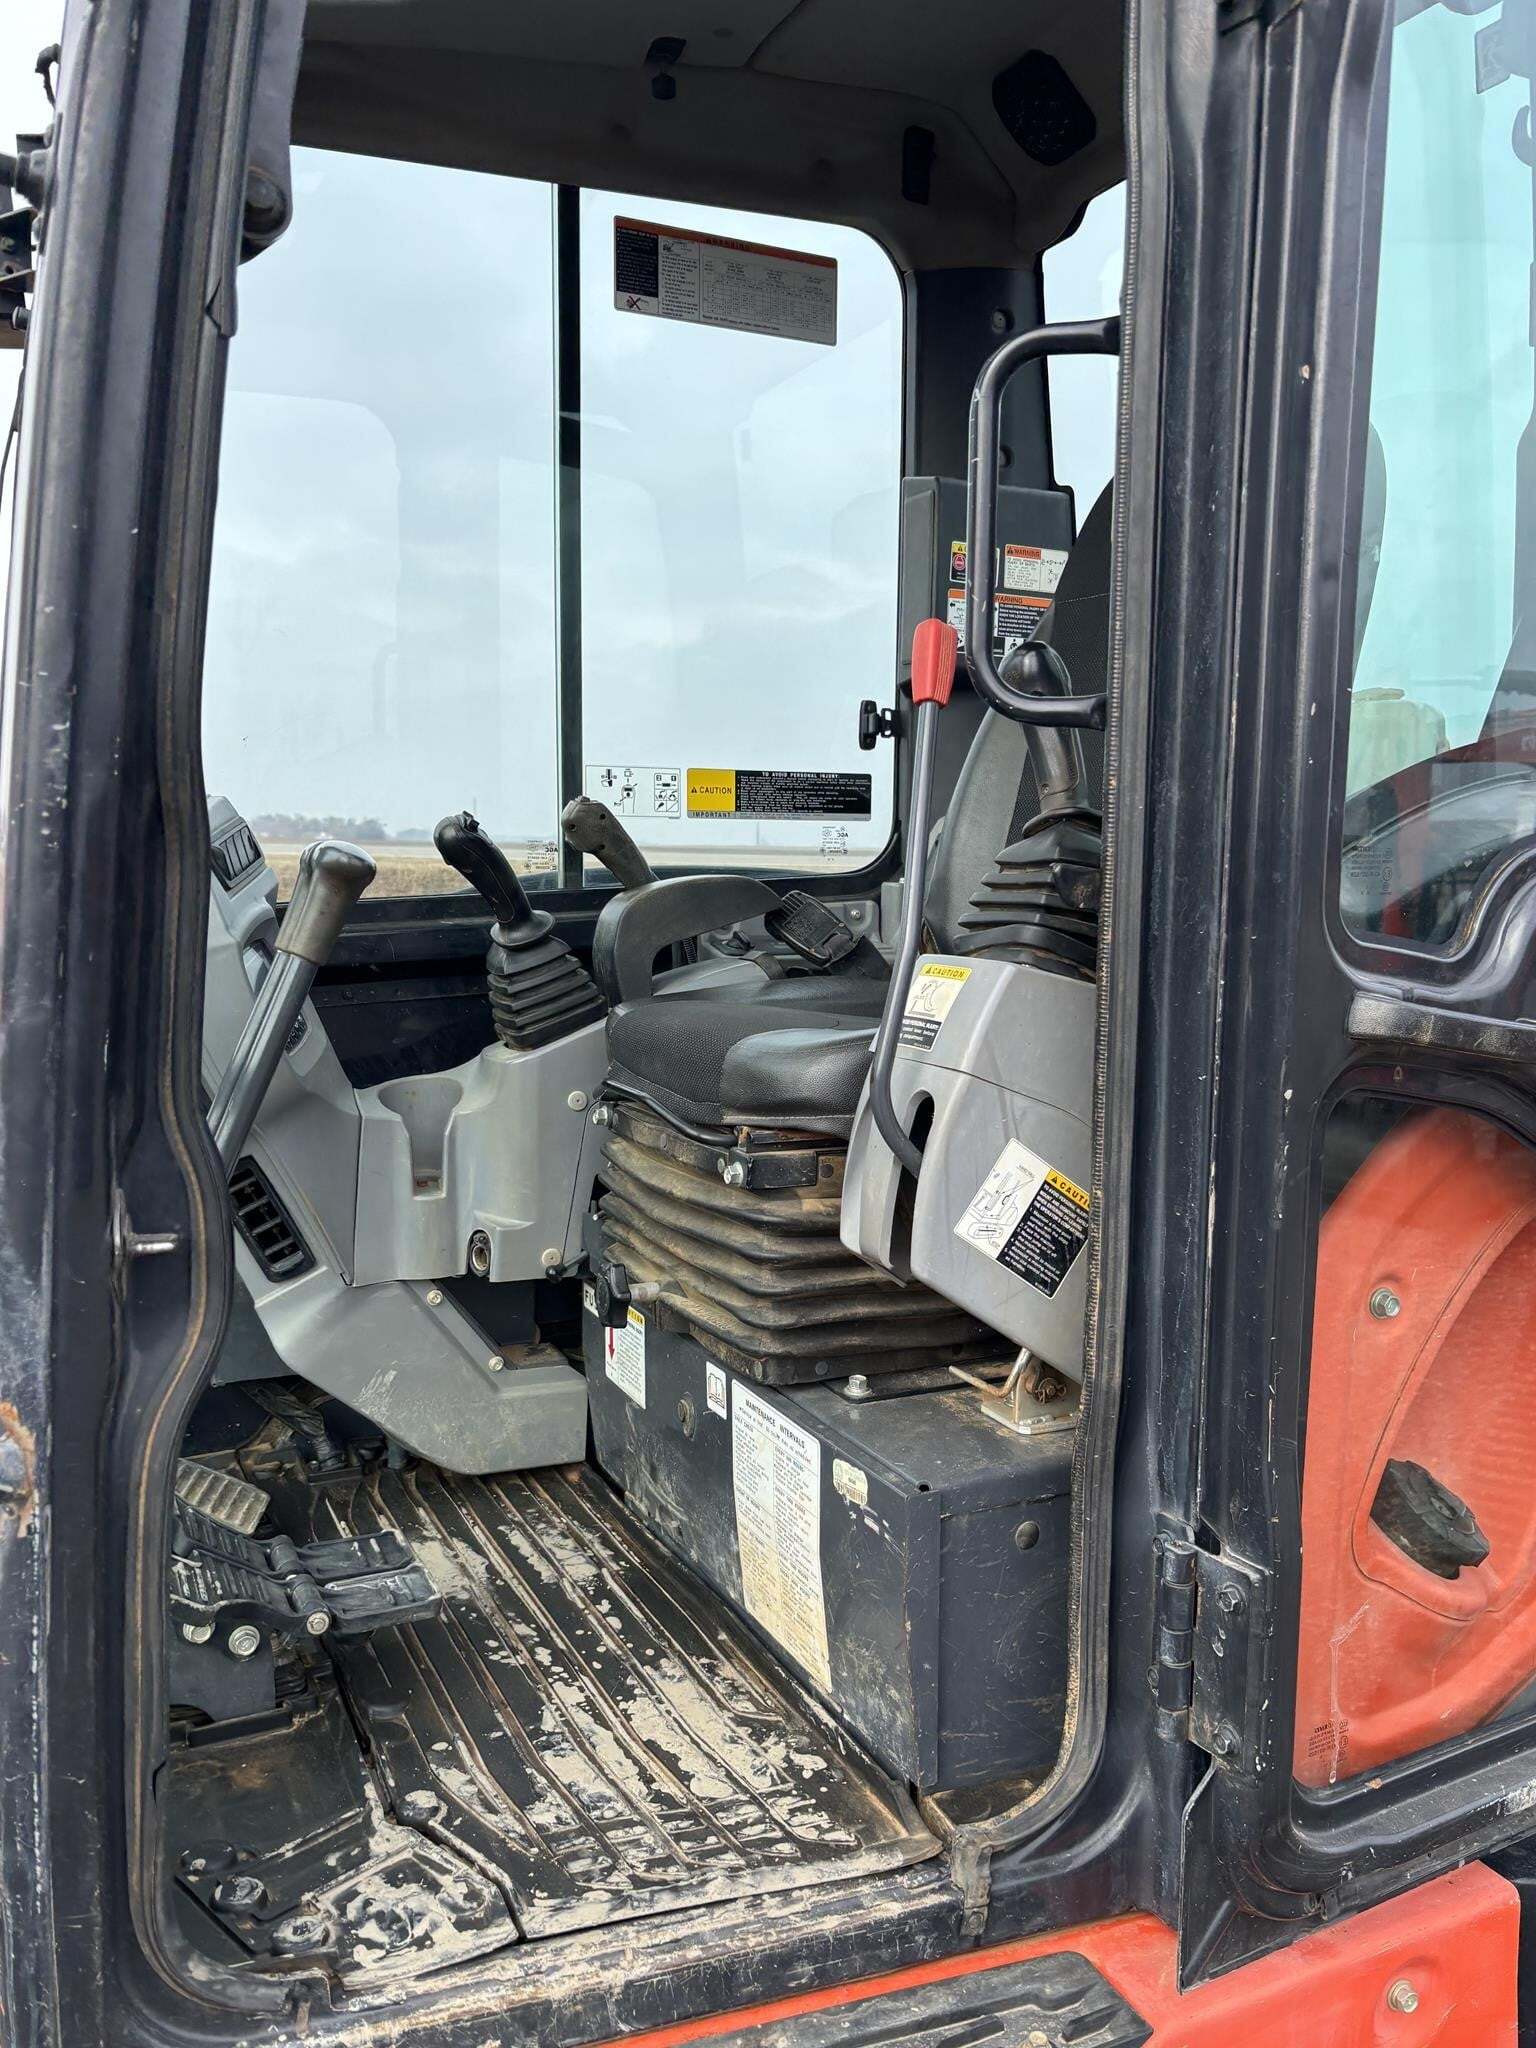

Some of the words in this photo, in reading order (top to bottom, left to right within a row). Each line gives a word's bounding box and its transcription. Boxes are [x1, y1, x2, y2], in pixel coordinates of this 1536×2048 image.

[699, 786, 732, 795] CAUTION
[692, 811, 731, 819] IMPORTANT
[932, 967, 964, 978] CAUTION
[1059, 1181, 1091, 1207] CAUTI
[745, 1399, 776, 1427] MAINTENANCE
[779, 1423, 805, 1449] INTERVALS
